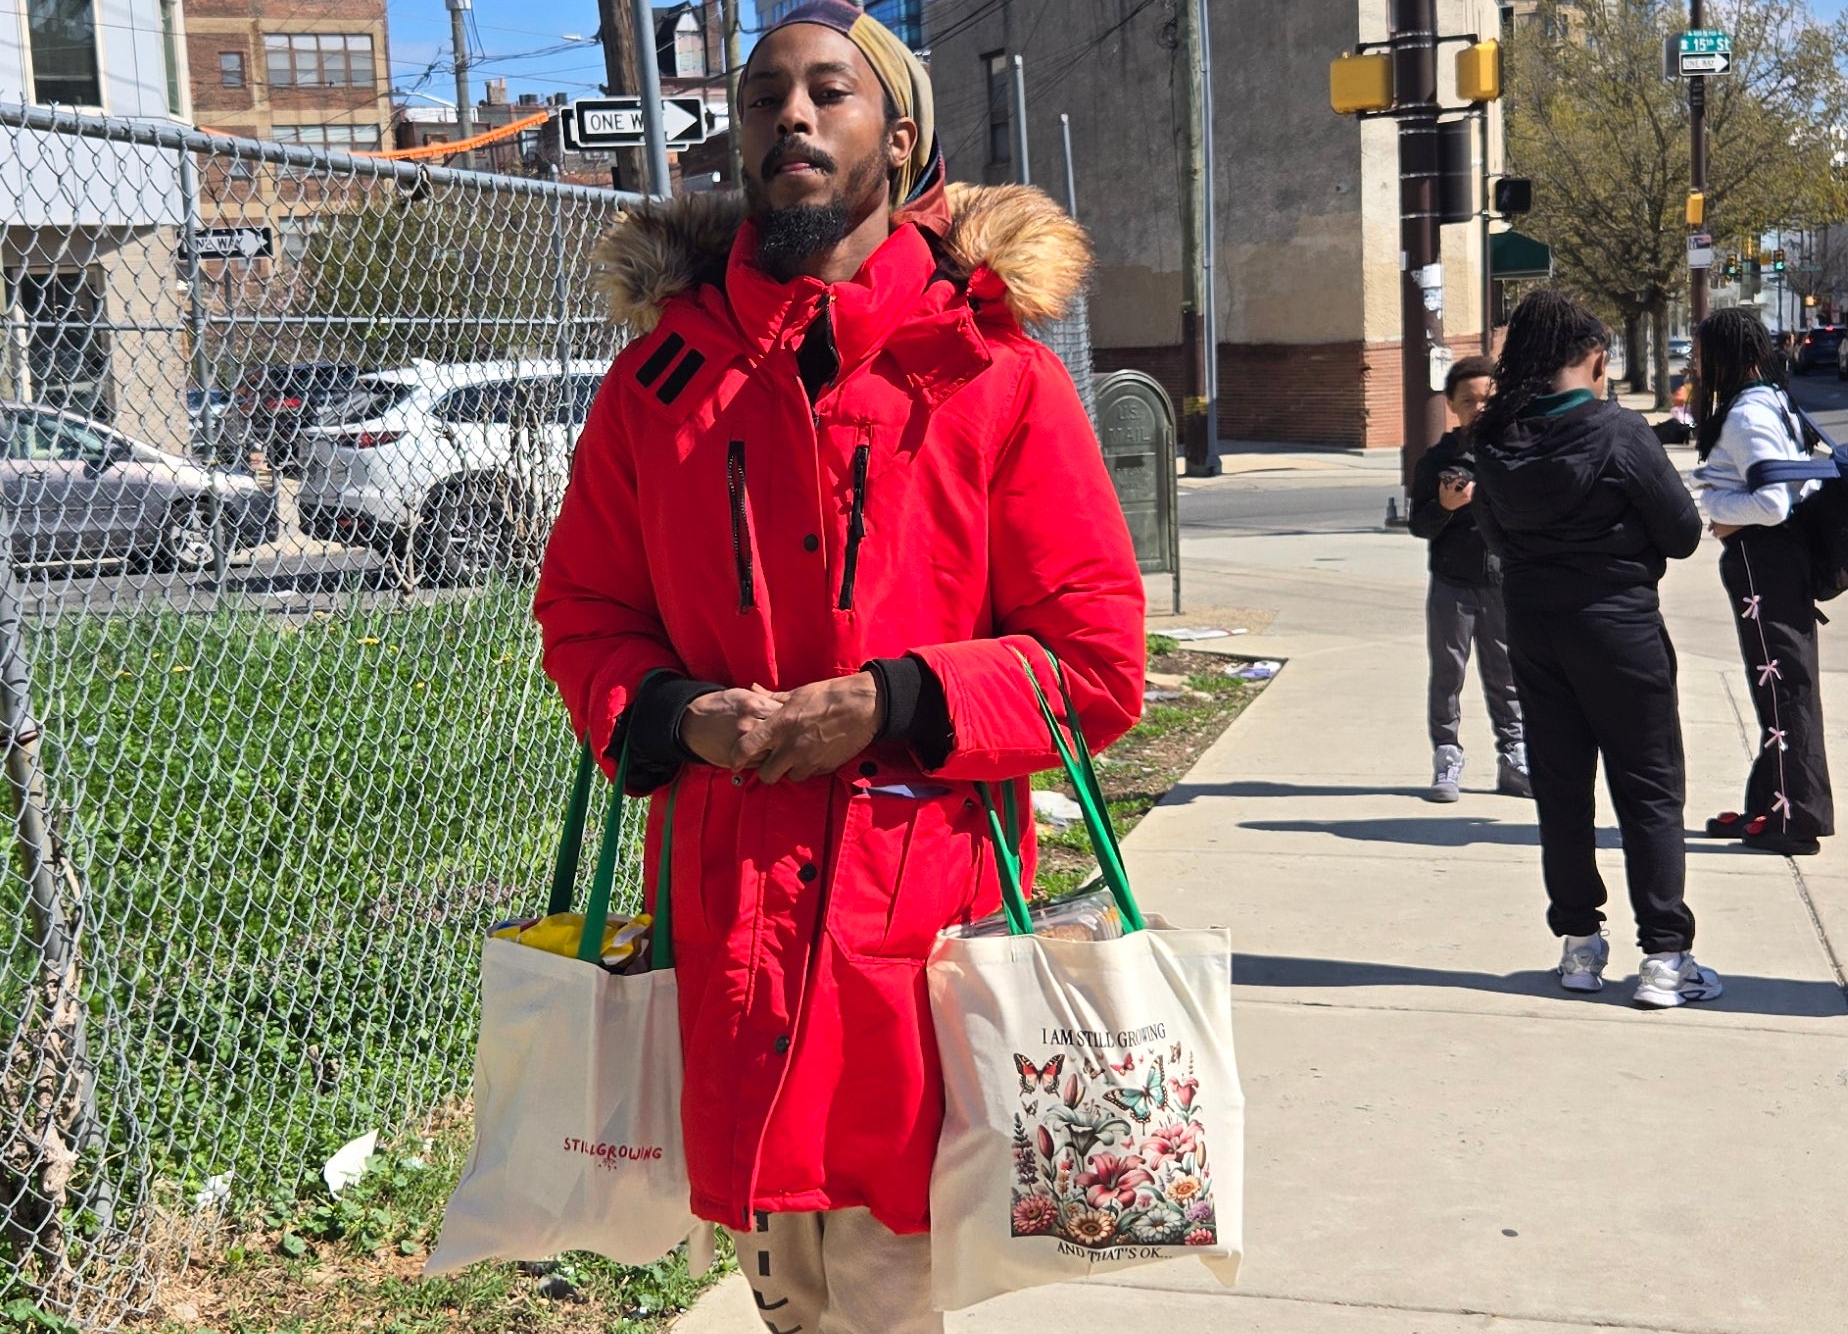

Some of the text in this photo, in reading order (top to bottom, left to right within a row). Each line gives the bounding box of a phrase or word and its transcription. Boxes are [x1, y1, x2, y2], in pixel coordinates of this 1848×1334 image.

[1716, 37, 1730, 51] St
[590, 113, 625, 130] ONE
[1107, 427, 1151, 442] MAIL
[1042, 1022, 1166, 1048] I AM STILL GROWING
[1057, 1241, 1085, 1258] AND
[1087, 1247, 1136, 1264] THAT'S
